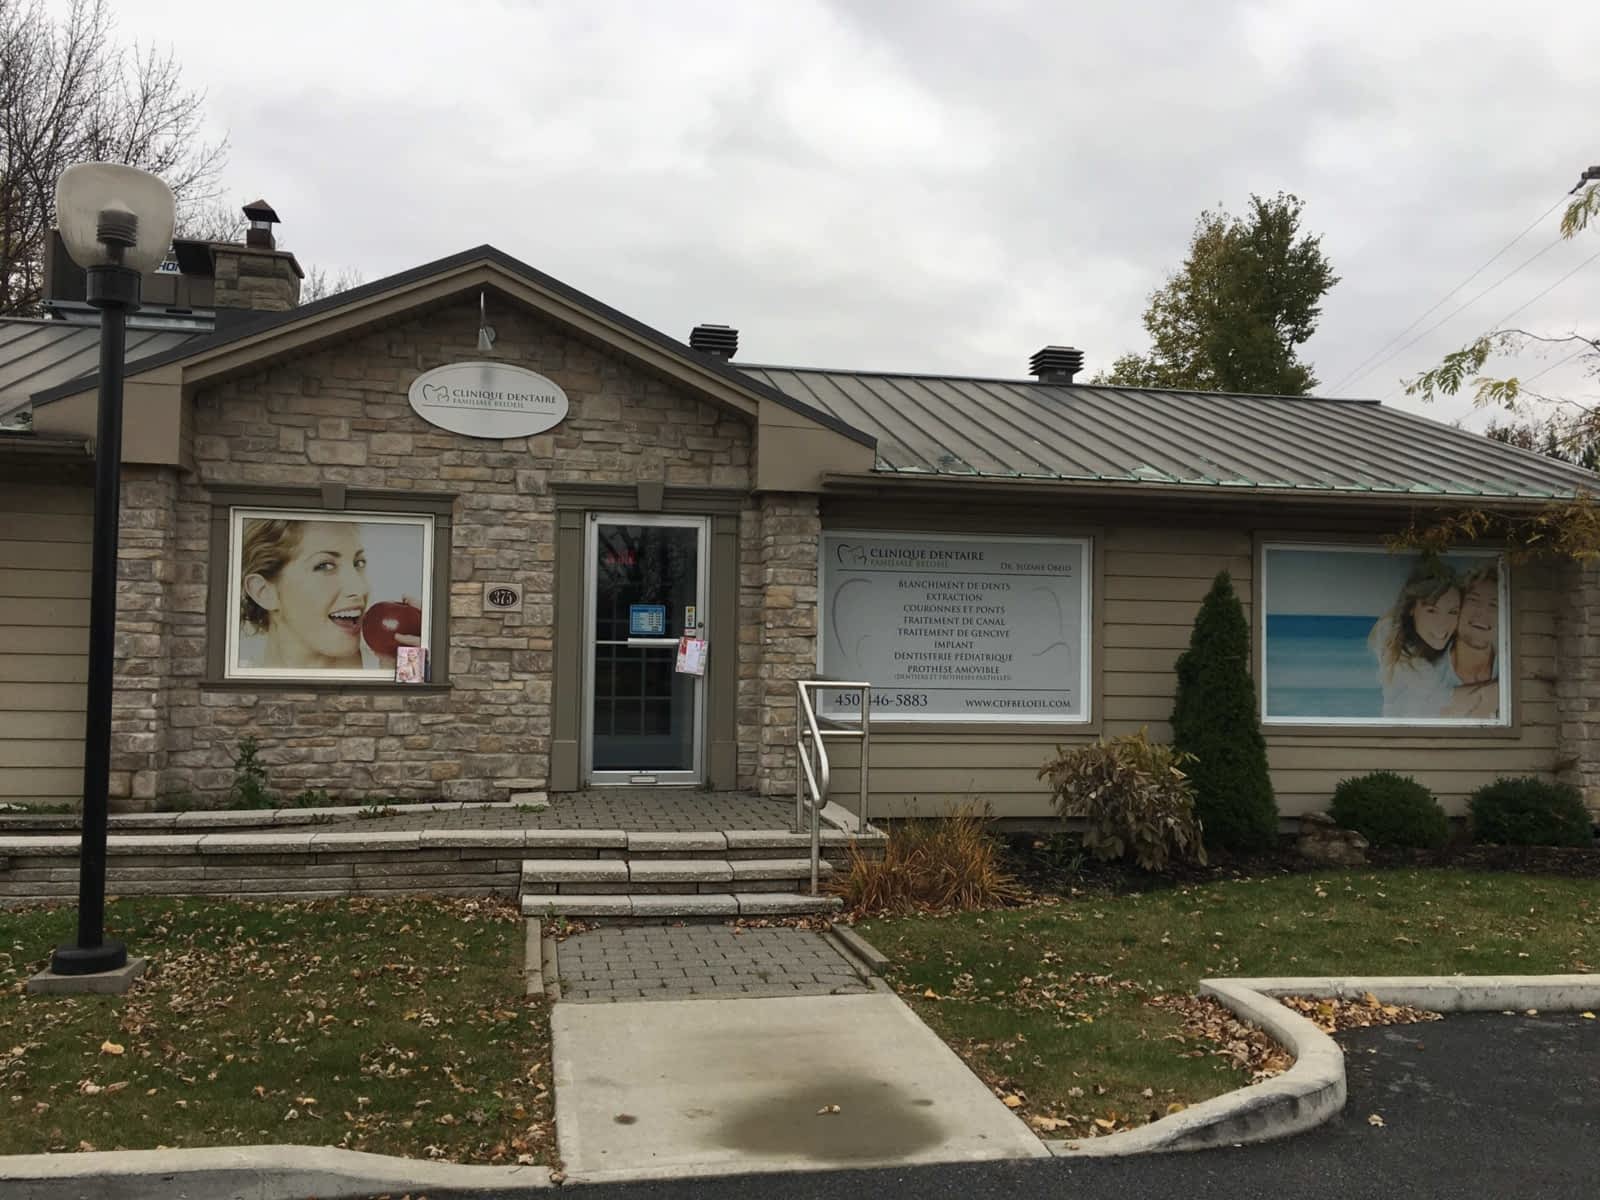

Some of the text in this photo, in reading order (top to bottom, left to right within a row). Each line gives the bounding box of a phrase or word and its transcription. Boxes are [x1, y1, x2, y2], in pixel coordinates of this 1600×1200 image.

[453, 389, 556, 404] CLINIQUE DENTAIRE
[870, 548, 984, 561] CLINIQUE DENTAIRE
[898, 580, 1011, 591] BLANCHIMENT DE DENTS
[493, 590, 513, 605] 375
[926, 593, 983, 601] EXTRACTION
[903, 604, 1006, 614] COURONNES ET PONTS
[904, 616, 1006, 626] TRAITEMENT DE CANAL
[898, 628, 1009, 638] TRAITEMENT DE GENCIVE
[934, 641, 974, 649] IMPLANT
[894, 652, 952, 661] DENTISTERIE
[955, 666, 1000, 674] AMOVIBLE
[835, 693, 860, 706] 450
